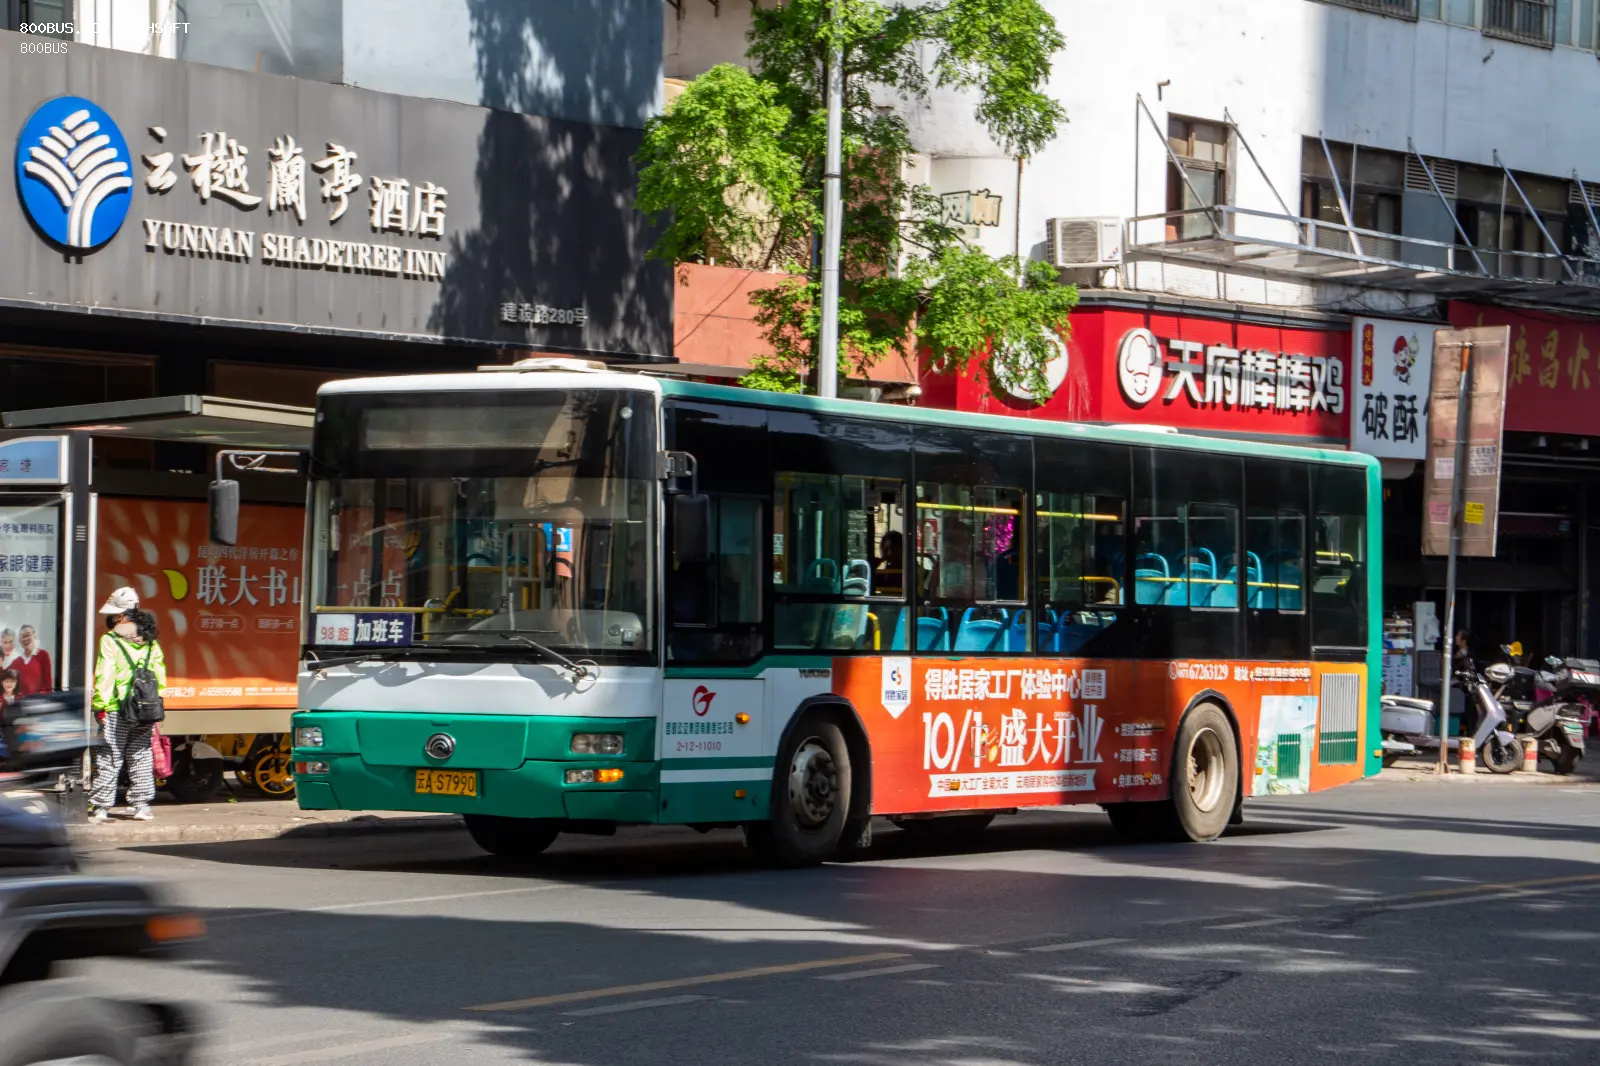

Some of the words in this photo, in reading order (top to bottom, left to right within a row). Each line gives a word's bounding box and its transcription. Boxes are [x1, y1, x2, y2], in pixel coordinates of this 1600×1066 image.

[143, 218, 254, 259] YUNNAN
[261, 232, 401, 273] SHADETREE
[403, 248, 447, 278] INN
[500, 302, 588, 327] 建设路280号
[1163, 338, 1344, 414] 天府棒棒鸡
[1362, 391, 1429, 444] 破酥
[320, 626, 335, 641] 98
[337, 627, 350, 642] 路
[355, 618, 405, 643] 加班车
[924, 668, 1081, 701] 得胜居家工厂体验中心
[996, 703, 1105, 767] 盛大开业
